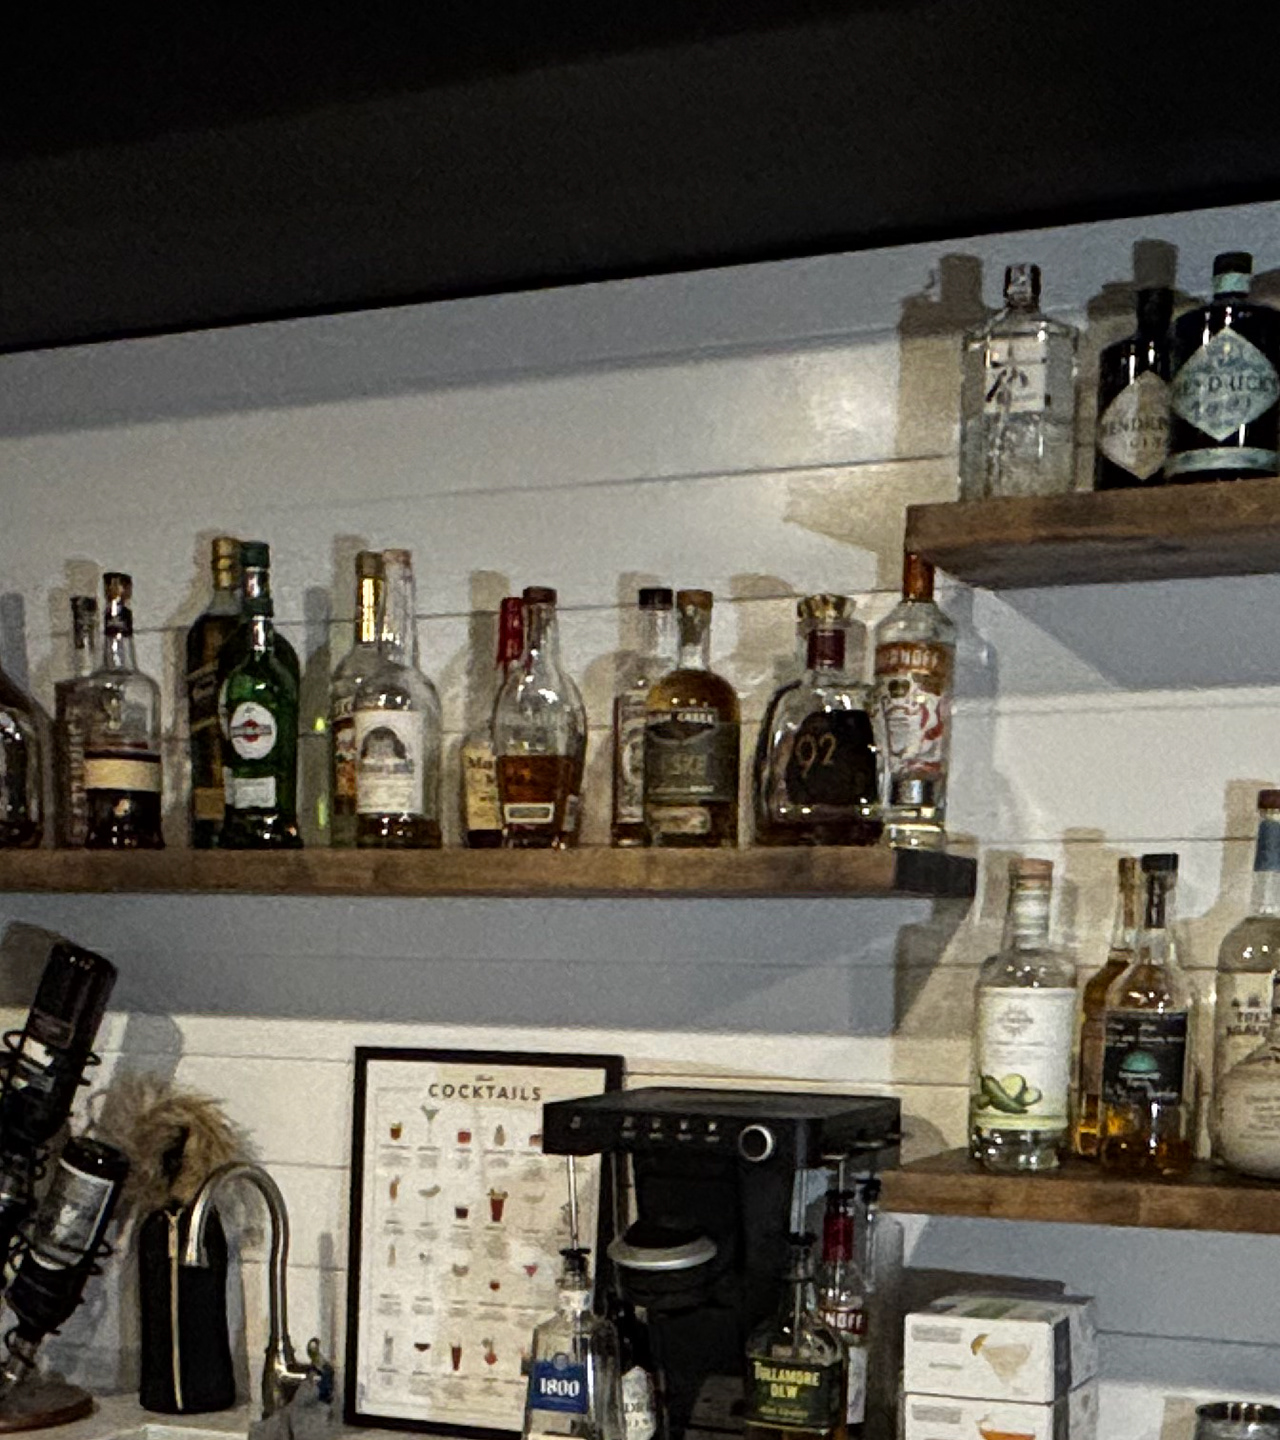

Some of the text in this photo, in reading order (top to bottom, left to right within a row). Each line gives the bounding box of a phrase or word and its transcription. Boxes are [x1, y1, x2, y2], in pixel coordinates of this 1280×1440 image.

[796, 733, 837, 779] 92
[428, 1083, 542, 1101] COCKTAILS
[825, 1312, 863, 1330] NOFF
[754, 1360, 821, 1387] TULLAMORE
[538, 1376, 580, 1398] 1800
